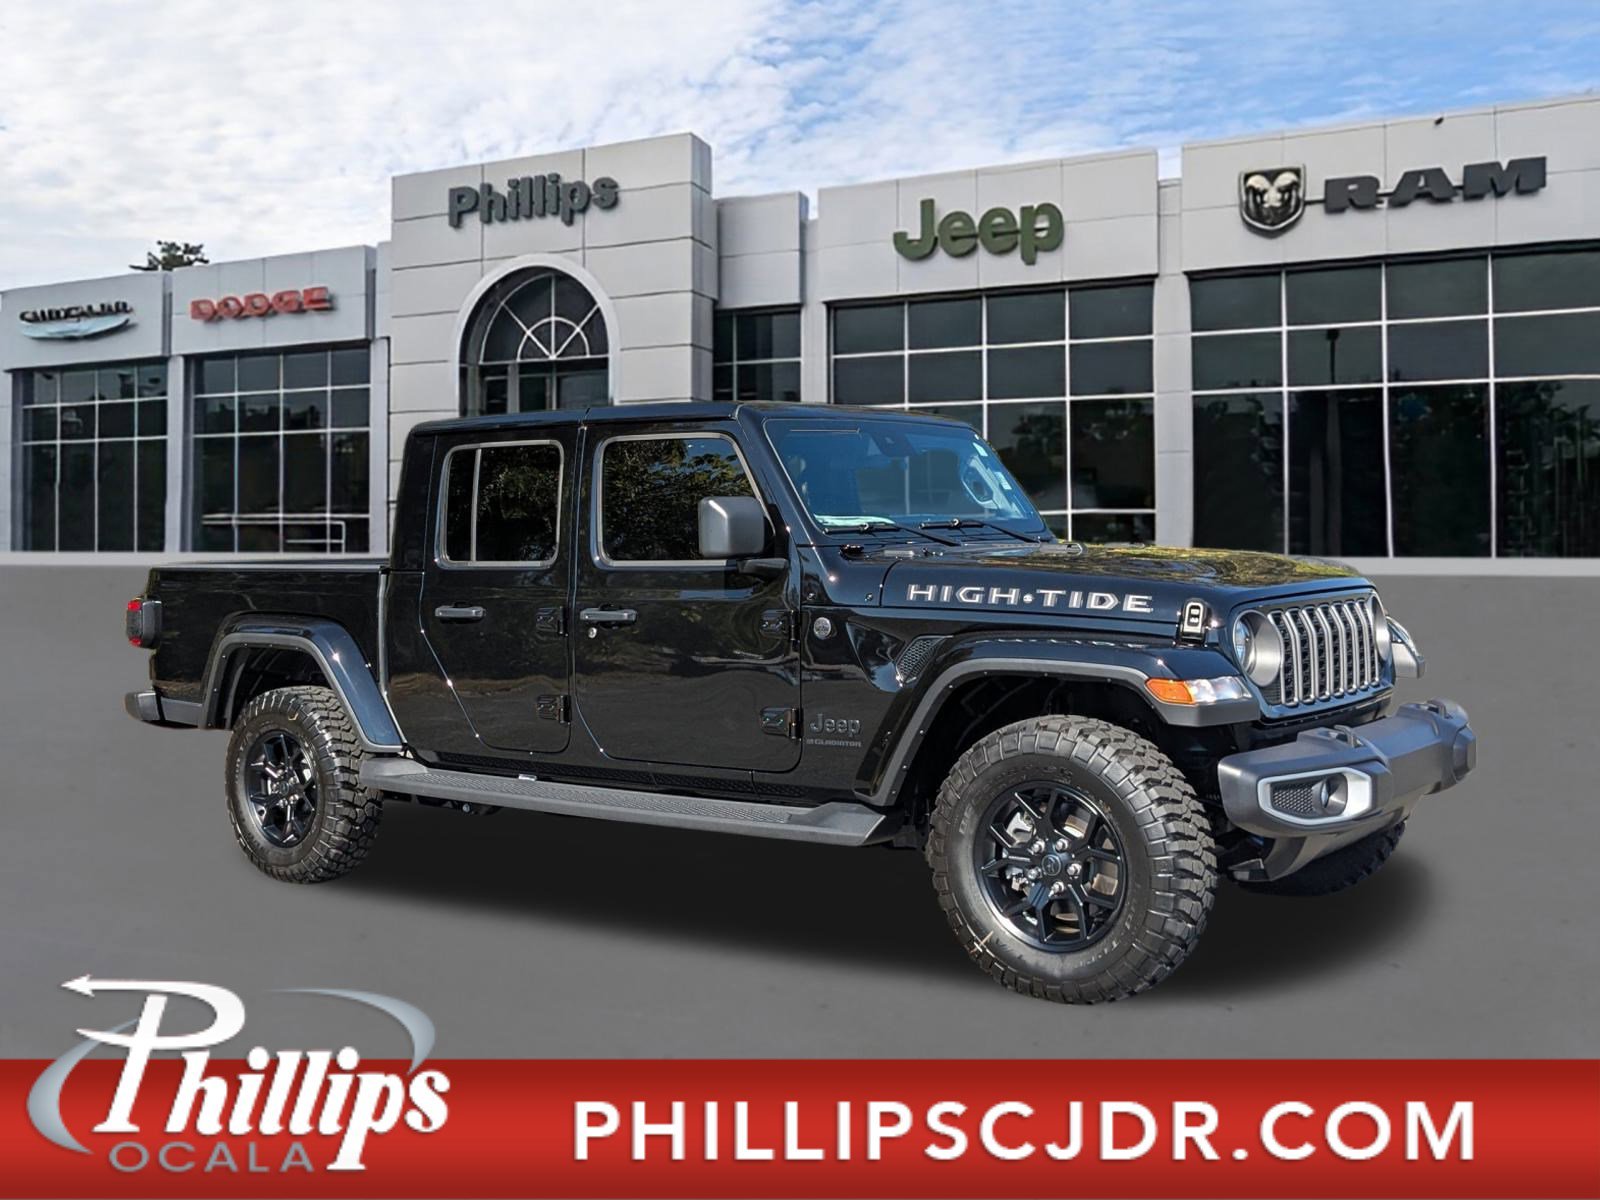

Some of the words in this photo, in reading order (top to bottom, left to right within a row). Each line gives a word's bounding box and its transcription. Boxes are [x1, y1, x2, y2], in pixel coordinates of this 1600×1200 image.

[448, 172, 620, 228] Phillips
[1324, 155, 1548, 214] RAM
[893, 198, 1065, 266] Jeep
[190, 285, 332, 323] DODGE
[906, 583, 1020, 606] HIGH
[1036, 588, 1155, 613] TIDE
[809, 713, 861, 738] Jeep
